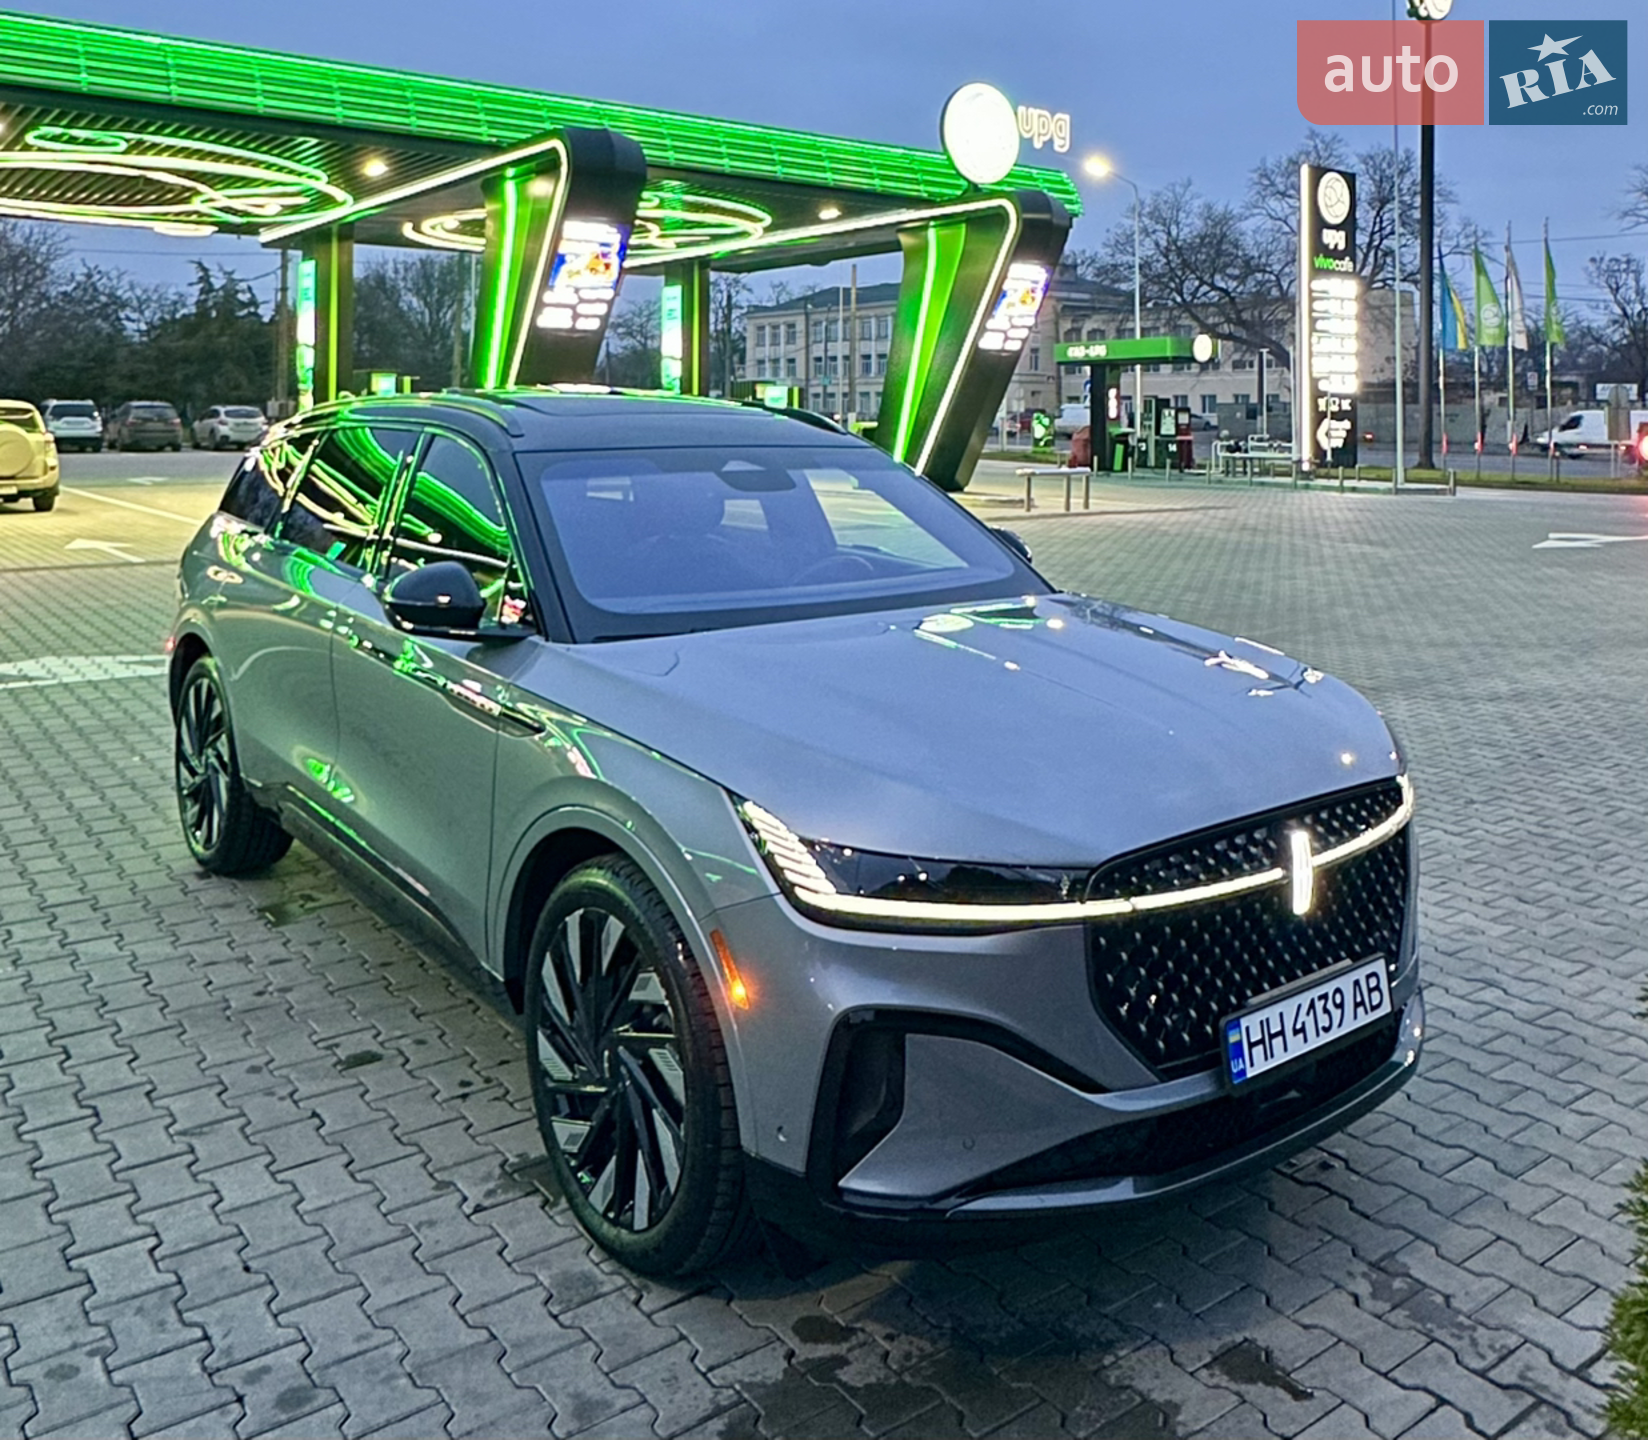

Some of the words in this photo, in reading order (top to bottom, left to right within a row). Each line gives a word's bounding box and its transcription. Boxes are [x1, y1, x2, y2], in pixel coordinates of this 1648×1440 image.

[1017, 105, 1071, 153] upg
[1244, 1011, 1288, 1069] HH
[1292, 986, 1345, 1045] 4139
[1352, 971, 1384, 1021] AB
[1230, 1058, 1245, 1074] UA
